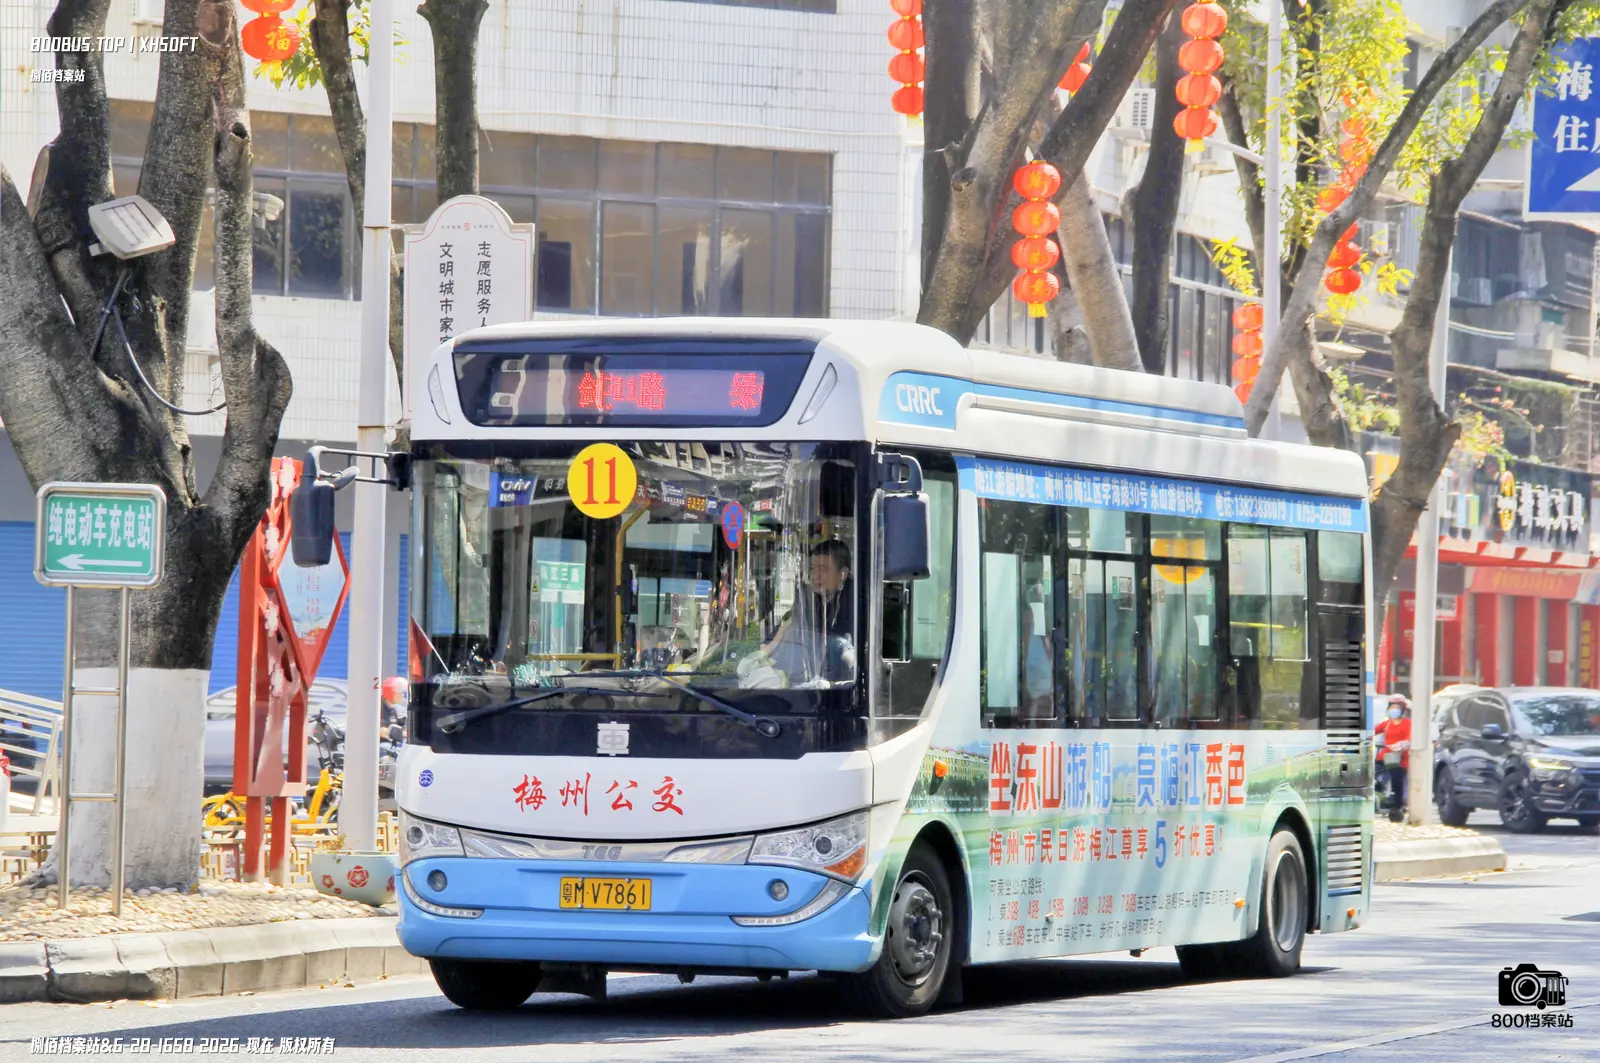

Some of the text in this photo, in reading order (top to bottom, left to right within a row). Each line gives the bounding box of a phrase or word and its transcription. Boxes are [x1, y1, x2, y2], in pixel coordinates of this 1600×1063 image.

[895, 383, 943, 416] CRRC
[582, 456, 622, 506] 11
[49, 502, 152, 549] 纯电动车充电站
[512, 772, 684, 816] 梅州公交
[990, 741, 1246, 812] 坐东山游船 赏梅江秀色
[581, 845, 623, 860] TEG
